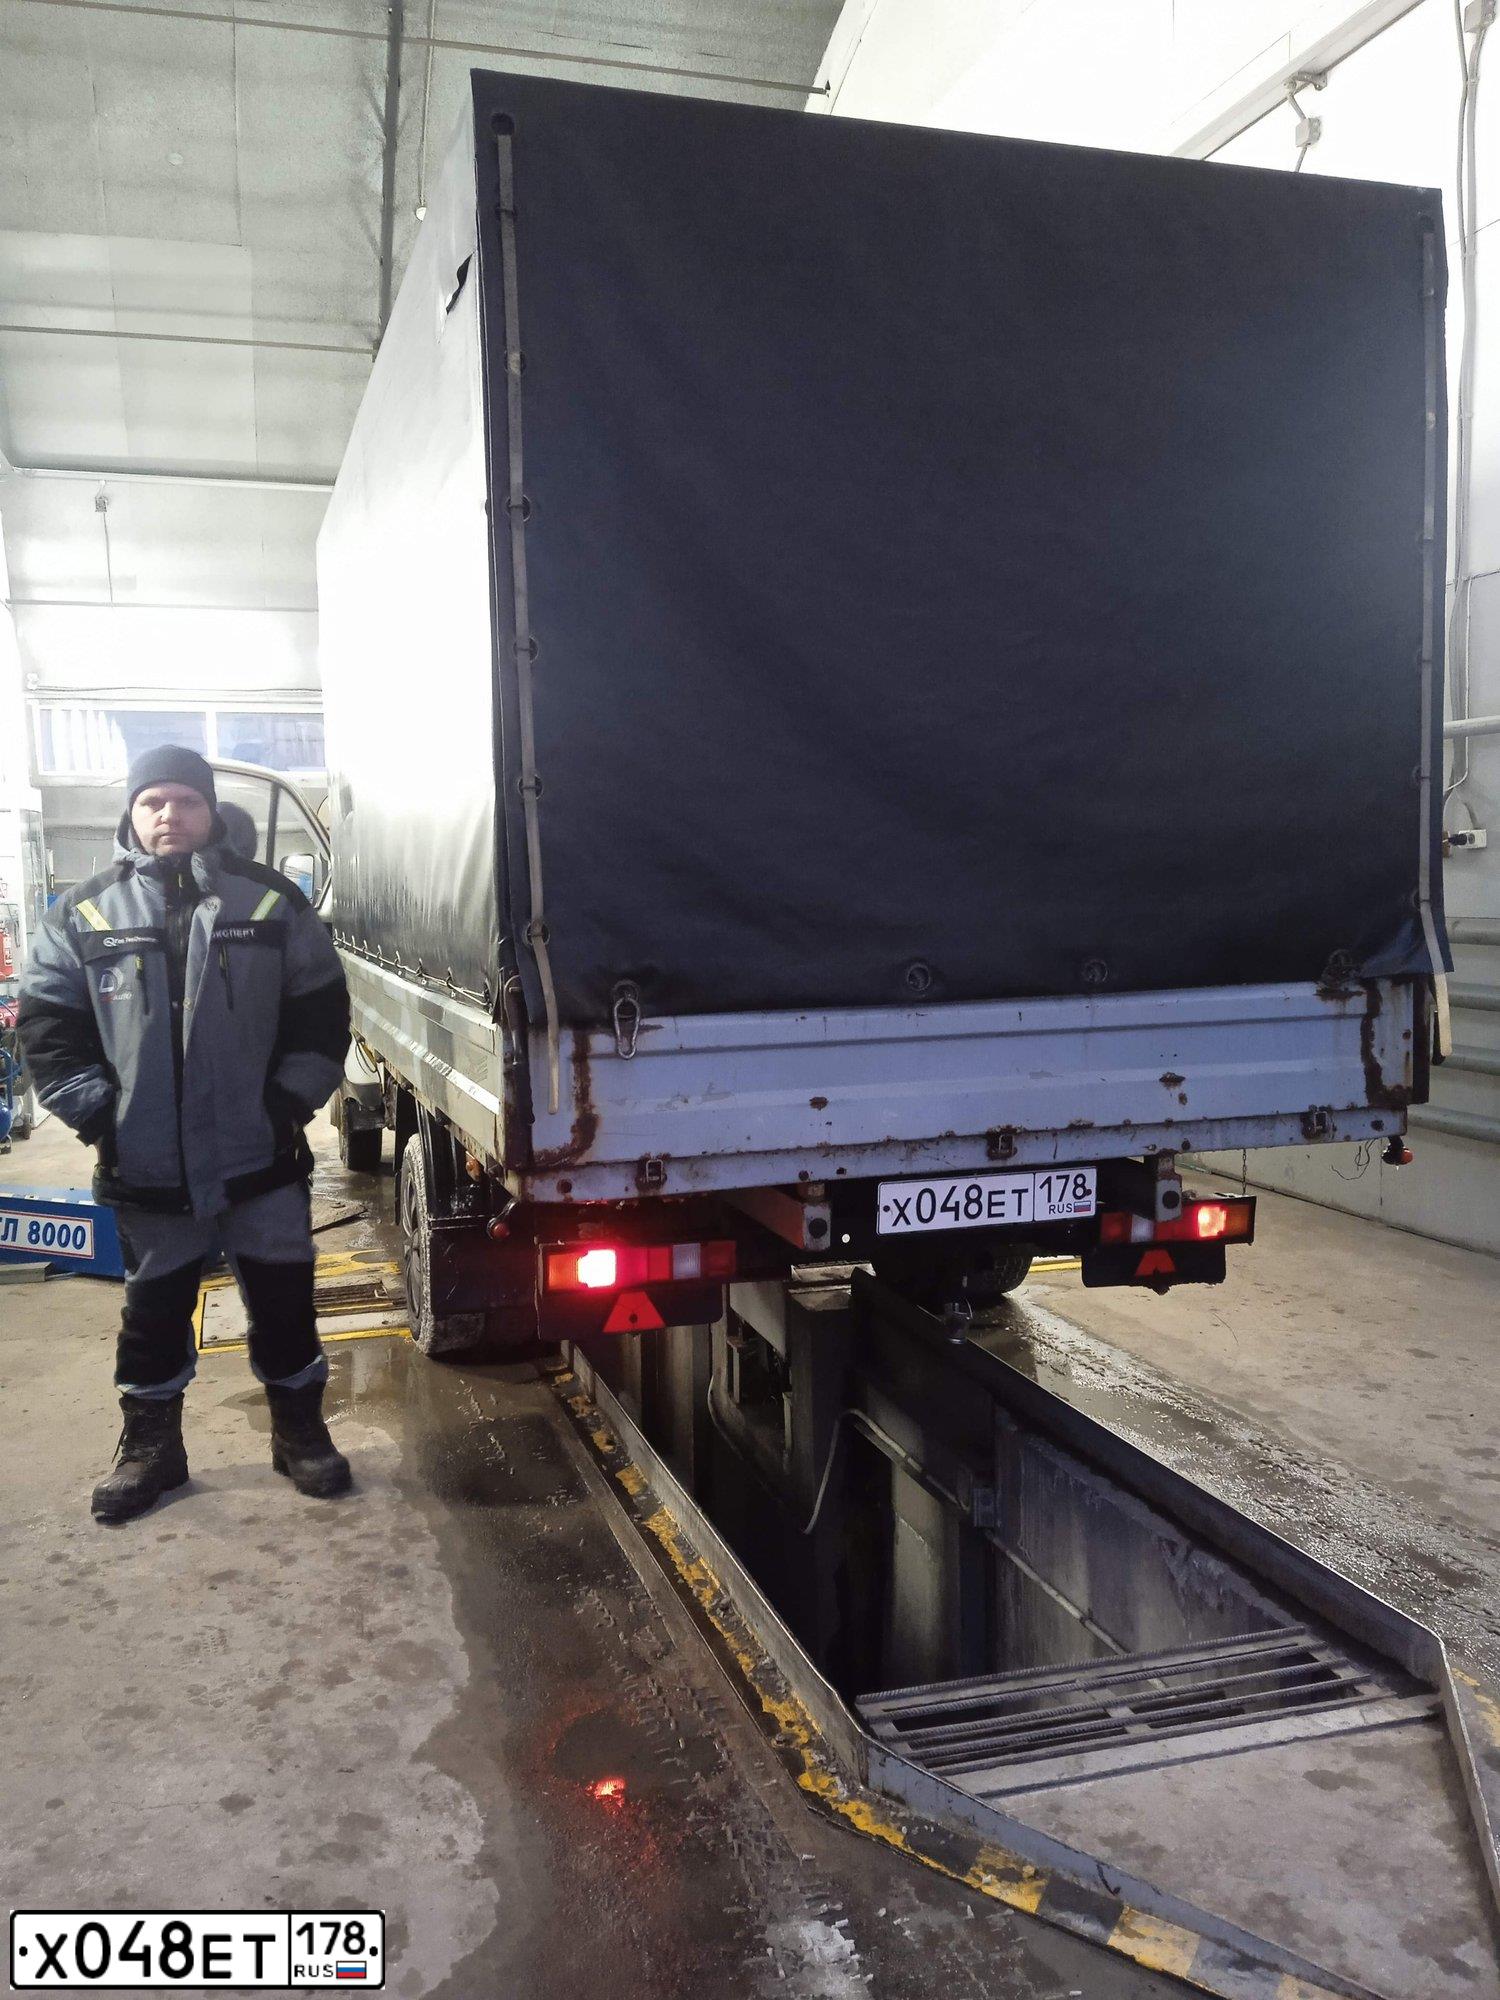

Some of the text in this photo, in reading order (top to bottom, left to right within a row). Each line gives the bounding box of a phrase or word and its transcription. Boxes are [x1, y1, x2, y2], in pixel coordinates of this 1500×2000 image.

[1039, 1173, 1087, 1204] 178
[1048, 1203, 1073, 1215] RUS
[27, 1220, 87, 1250] 8000
